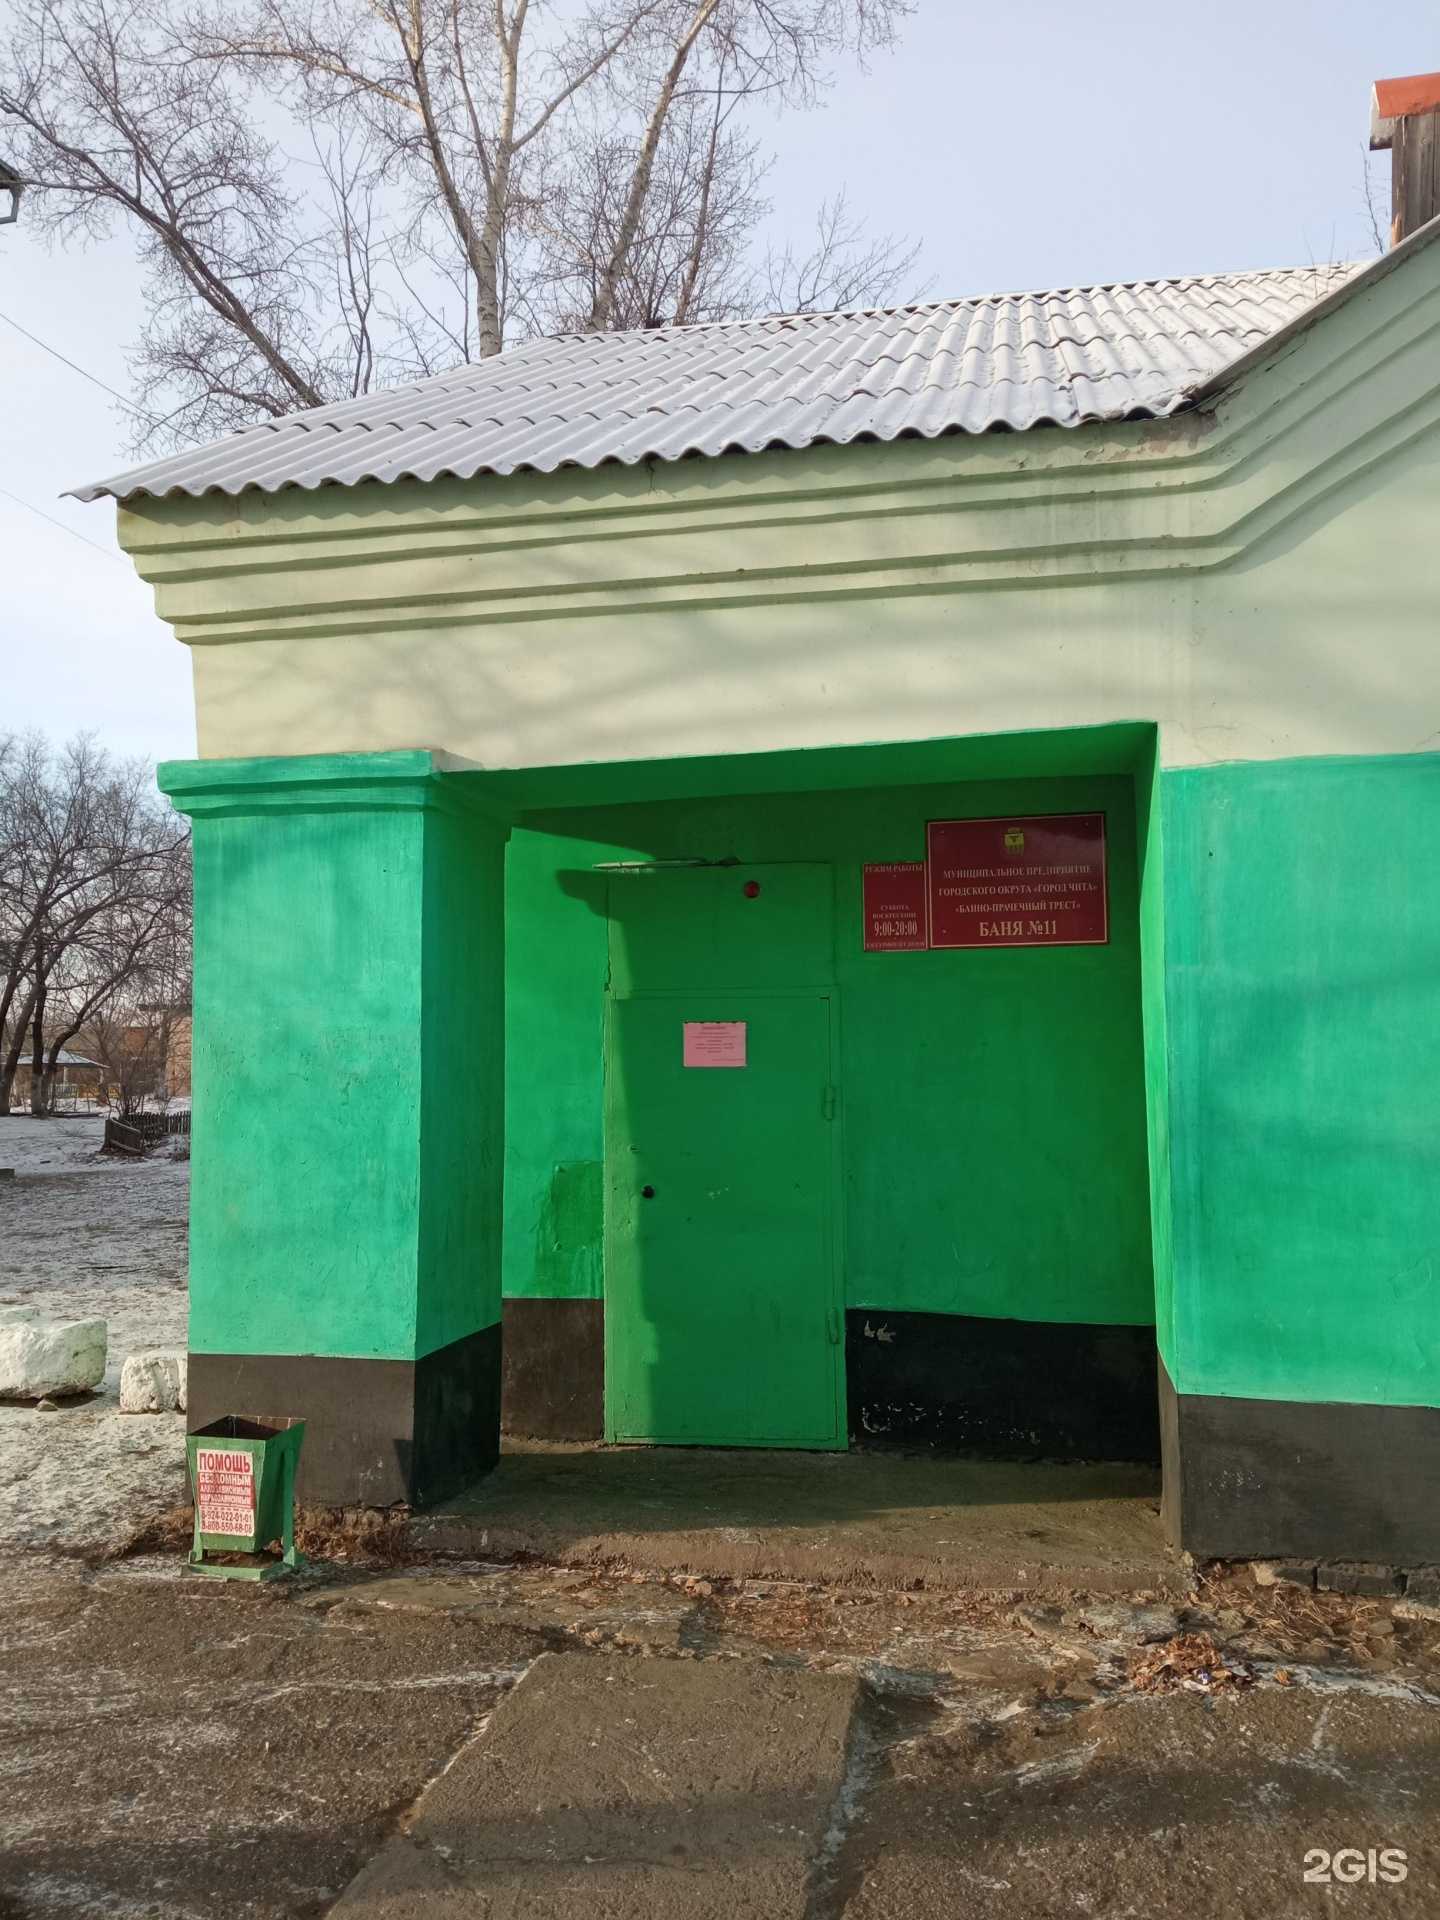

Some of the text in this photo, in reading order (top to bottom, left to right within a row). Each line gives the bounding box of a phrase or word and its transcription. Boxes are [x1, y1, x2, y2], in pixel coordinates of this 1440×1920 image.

[943, 865, 1090, 879] МУНИЦИПАЛЬНОЕ ПРЕДПРИЯТИЕ
[938, 886, 996, 896] ГОРОДСКОГО
[998, 884, 1032, 895] ОКРУГА
[874, 920, 918, 936] 9:00-20:00
[979, 919, 1057, 937] БАНЯ №11
[199, 1453, 251, 1473] ПОМОЩЬ
[199, 1473, 251, 1486] БЕЗДОМНЫМ
